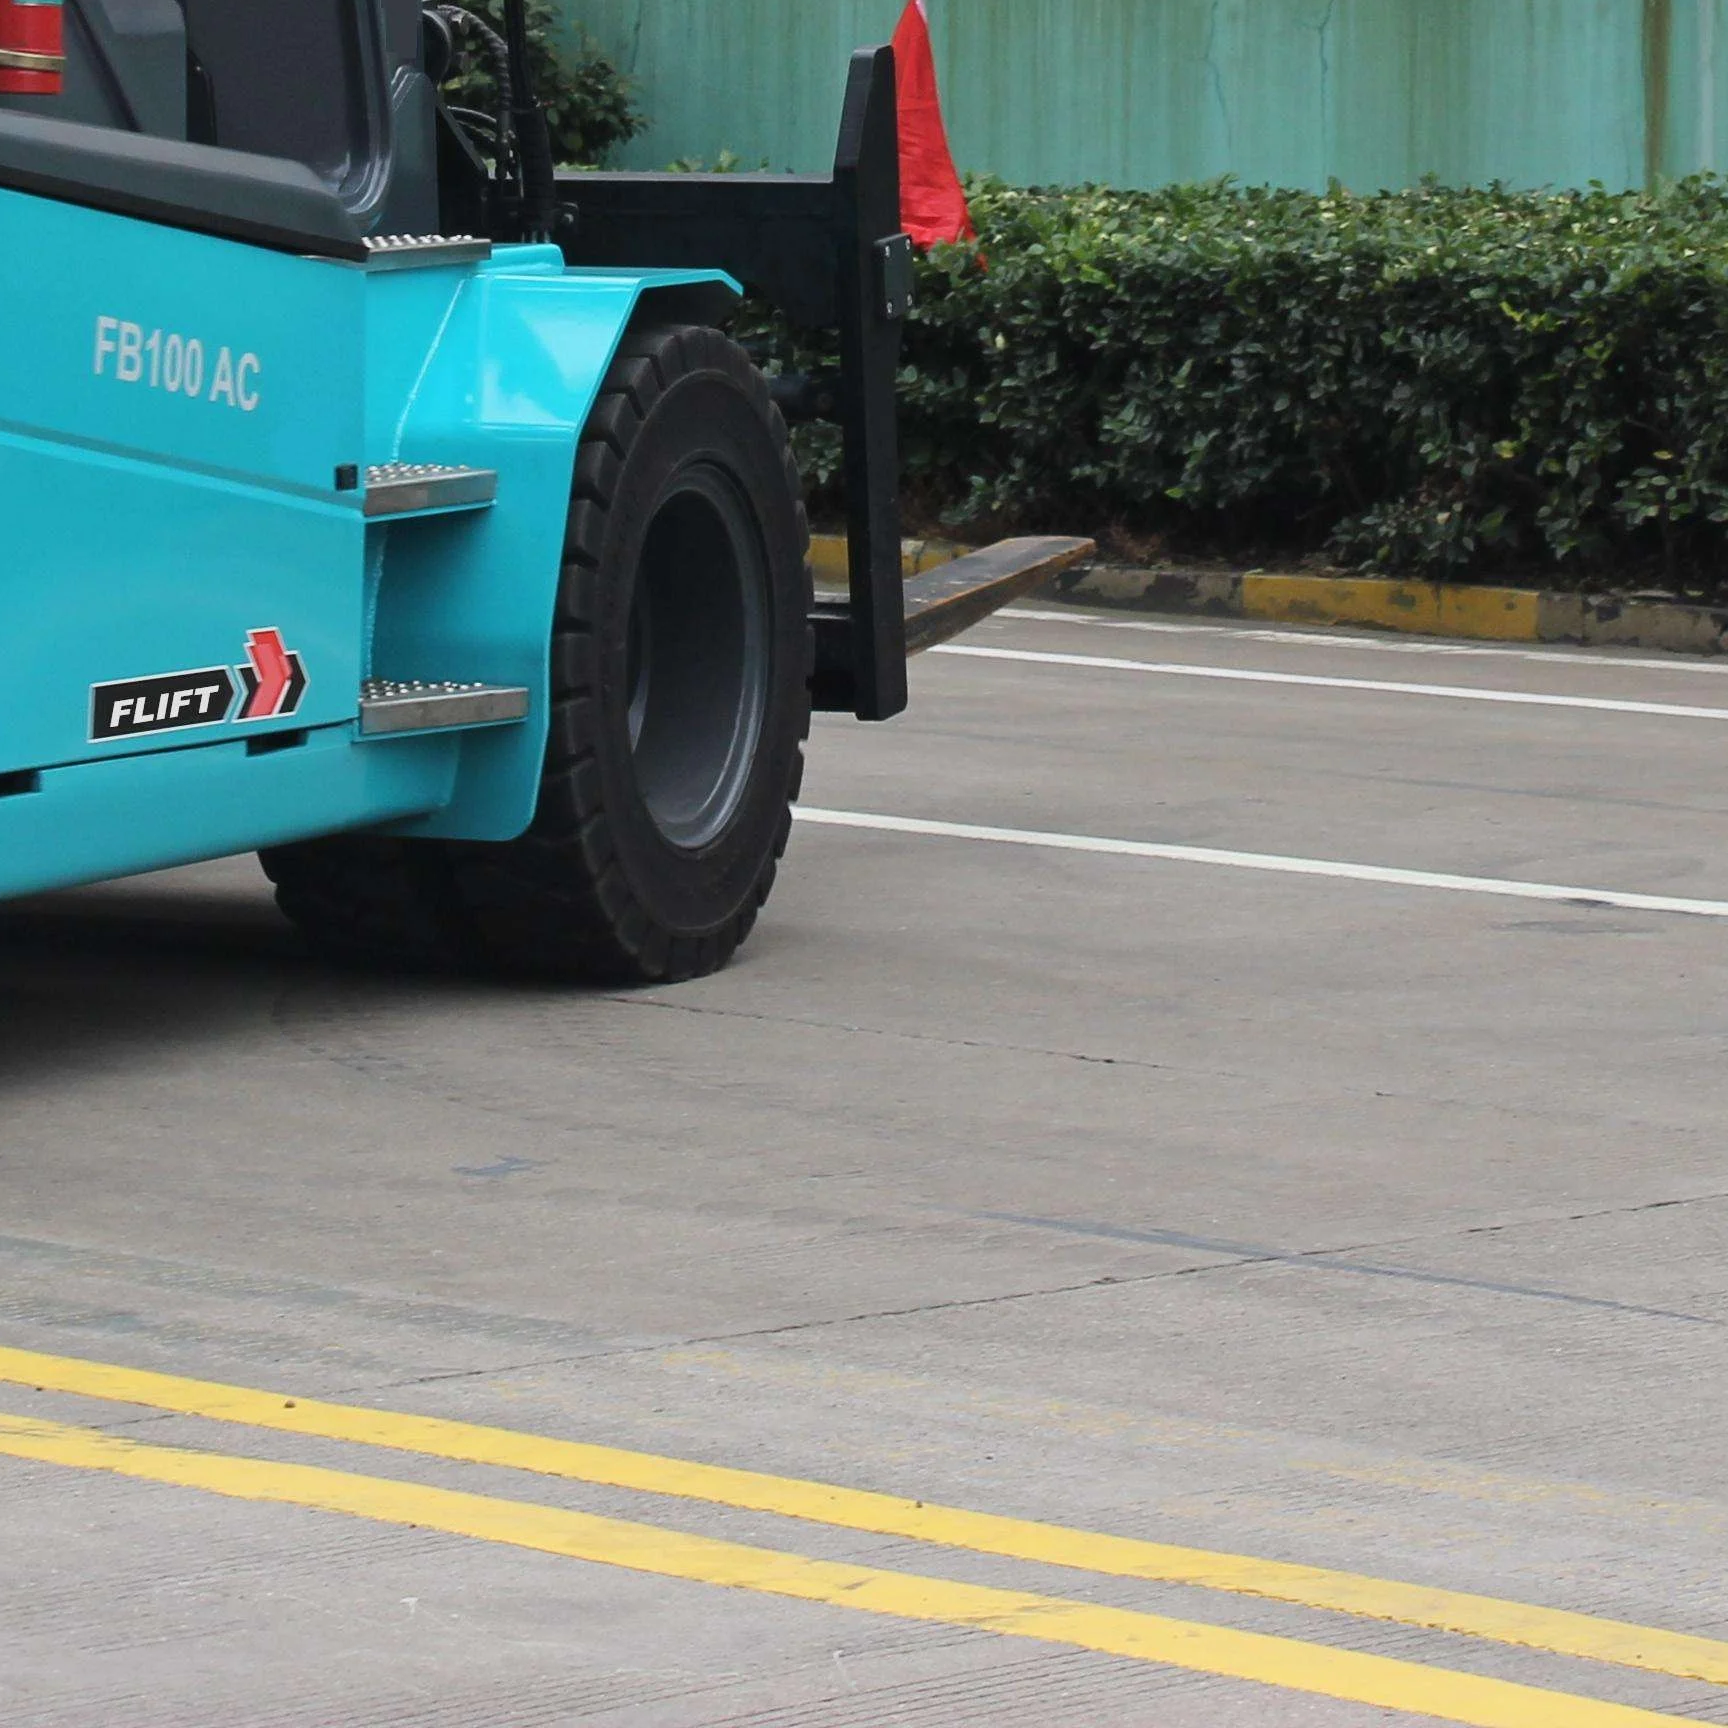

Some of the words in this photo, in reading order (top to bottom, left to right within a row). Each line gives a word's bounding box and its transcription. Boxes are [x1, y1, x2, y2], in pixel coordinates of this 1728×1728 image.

[93, 315, 204, 398] FB100
[208, 346, 261, 412] AC
[109, 684, 220, 728] FLIFT
